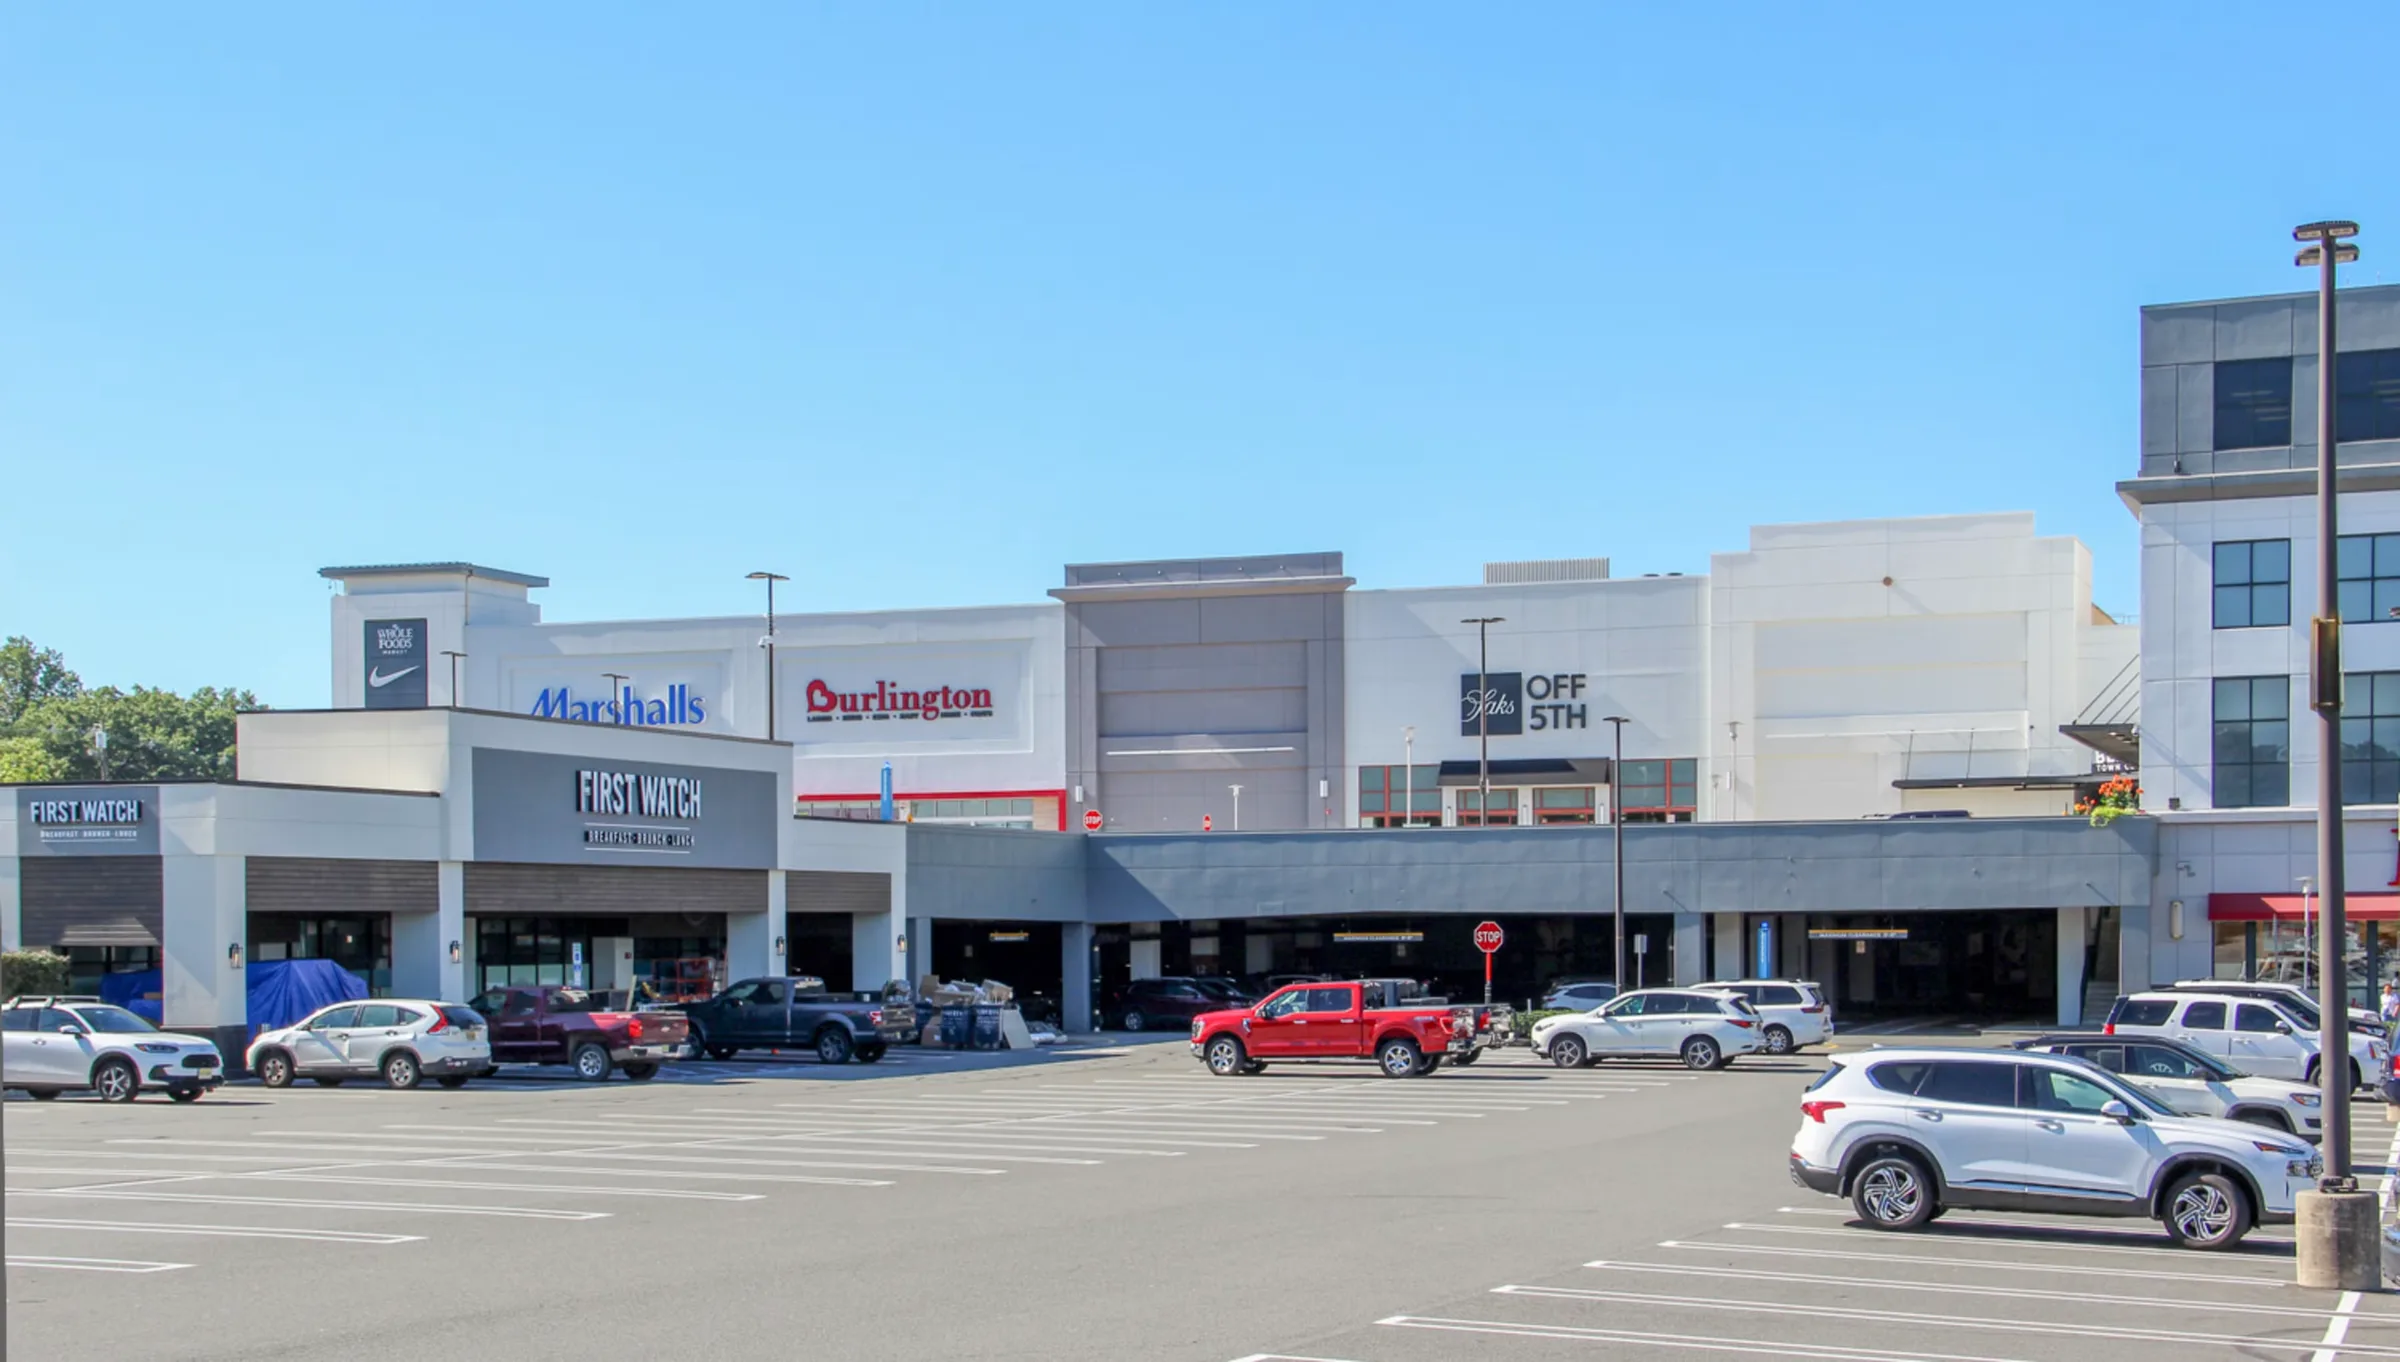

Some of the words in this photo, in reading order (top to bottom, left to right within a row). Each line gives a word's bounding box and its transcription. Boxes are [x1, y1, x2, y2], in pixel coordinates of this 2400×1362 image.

[377, 627, 413, 638] WHOLE
[379, 639, 412, 649] FOODS
[807, 680, 992, 720] Burlington
[1526, 674, 1586, 700] OFF
[531, 684, 706, 726] Marshalls
[1529, 703, 1587, 731] 5TH
[578, 770, 636, 815] FIRST
[640, 775, 701, 819] WATCH
[30, 801, 79, 823] FIRST
[81, 800, 139, 822] WATCH
[1477, 931, 1501, 942] STOP
